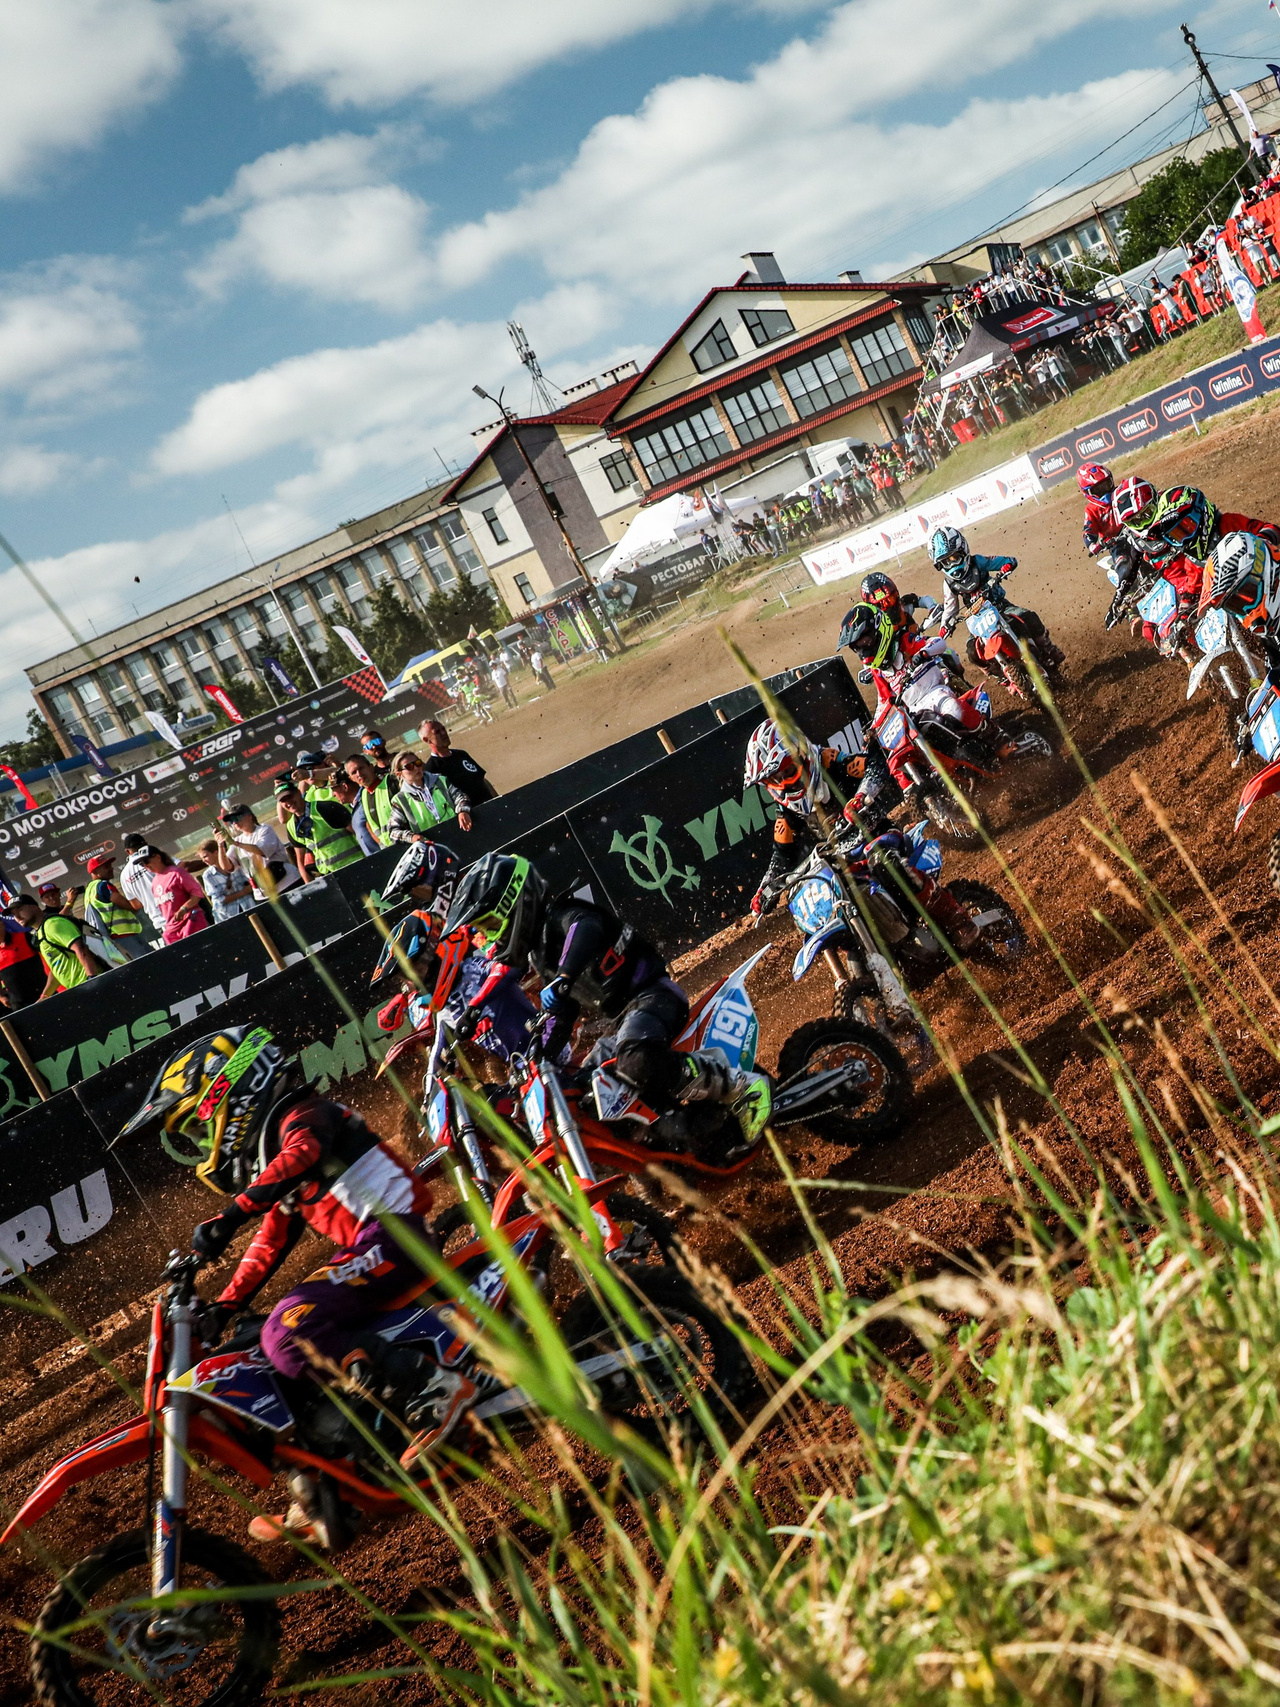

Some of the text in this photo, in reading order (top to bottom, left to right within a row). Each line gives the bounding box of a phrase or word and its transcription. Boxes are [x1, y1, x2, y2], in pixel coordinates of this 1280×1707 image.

[1211, 374, 1244, 396] Winline
[1164, 396, 1192, 418] Winline
[1120, 416, 1148, 437] Winline
[1078, 435, 1105, 456] Winline
[1040, 454, 1065, 476] Winline
[1007, 472, 1032, 488] LEMARC
[966, 492, 989, 508] LEMARC
[929, 510, 950, 524] LEMARC
[890, 527, 911, 542] LEMARC
[651, 555, 706, 585] РЕСТОБАР
[545, 609, 574, 658] СТАРТ
[975, 610, 998, 636] 116
[202, 729, 242, 757] RGP
[12, 774, 137, 837] МОТОКРОССУ
[77, 846, 105, 862] Winline
[496, 873, 524, 918] 100%
[711, 1000, 753, 1048] 191
